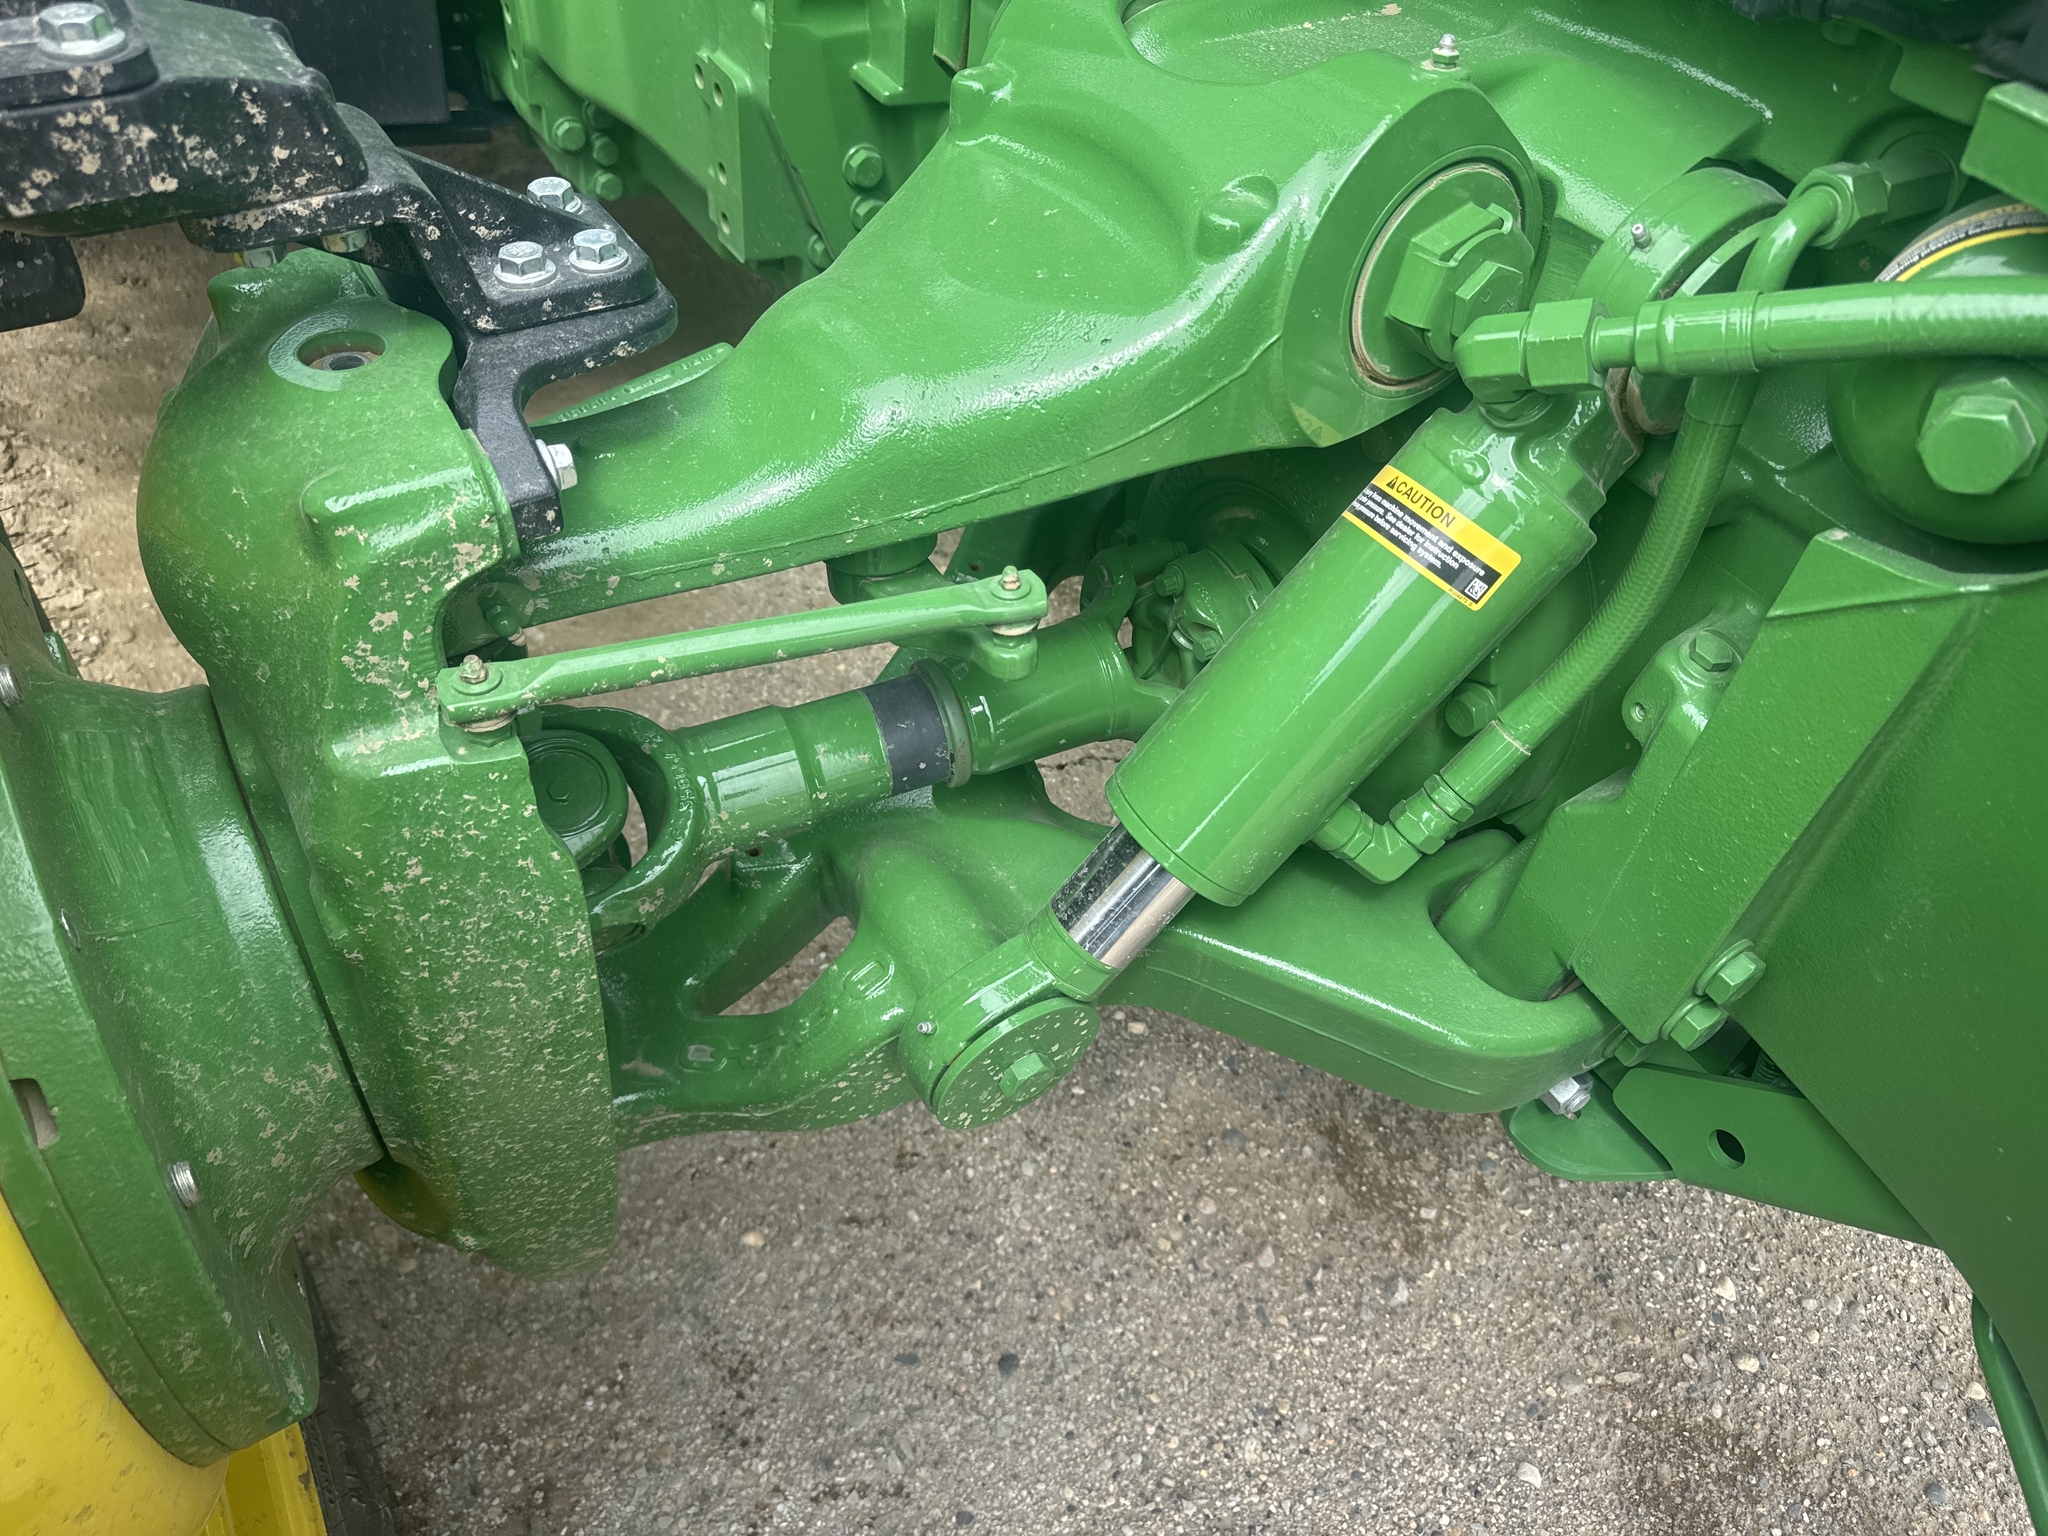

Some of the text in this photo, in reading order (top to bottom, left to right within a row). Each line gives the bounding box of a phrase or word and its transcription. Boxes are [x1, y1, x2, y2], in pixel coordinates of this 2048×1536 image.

[1396, 481, 1456, 528] CAUTION
[1373, 515, 1391, 530] before
[1389, 526, 1418, 552] servicing
[1416, 546, 1442, 569] system.
[1381, 499, 1404, 518] machine
[1402, 514, 1439, 543] movement
[1437, 536, 1455, 555] and
[1452, 548, 1485, 577] exposure
[1385, 512, 1397, 523] See
[1395, 520, 1415, 537] dealer
[1413, 532, 1425, 544] for
[1423, 541, 1460, 569] instruction
